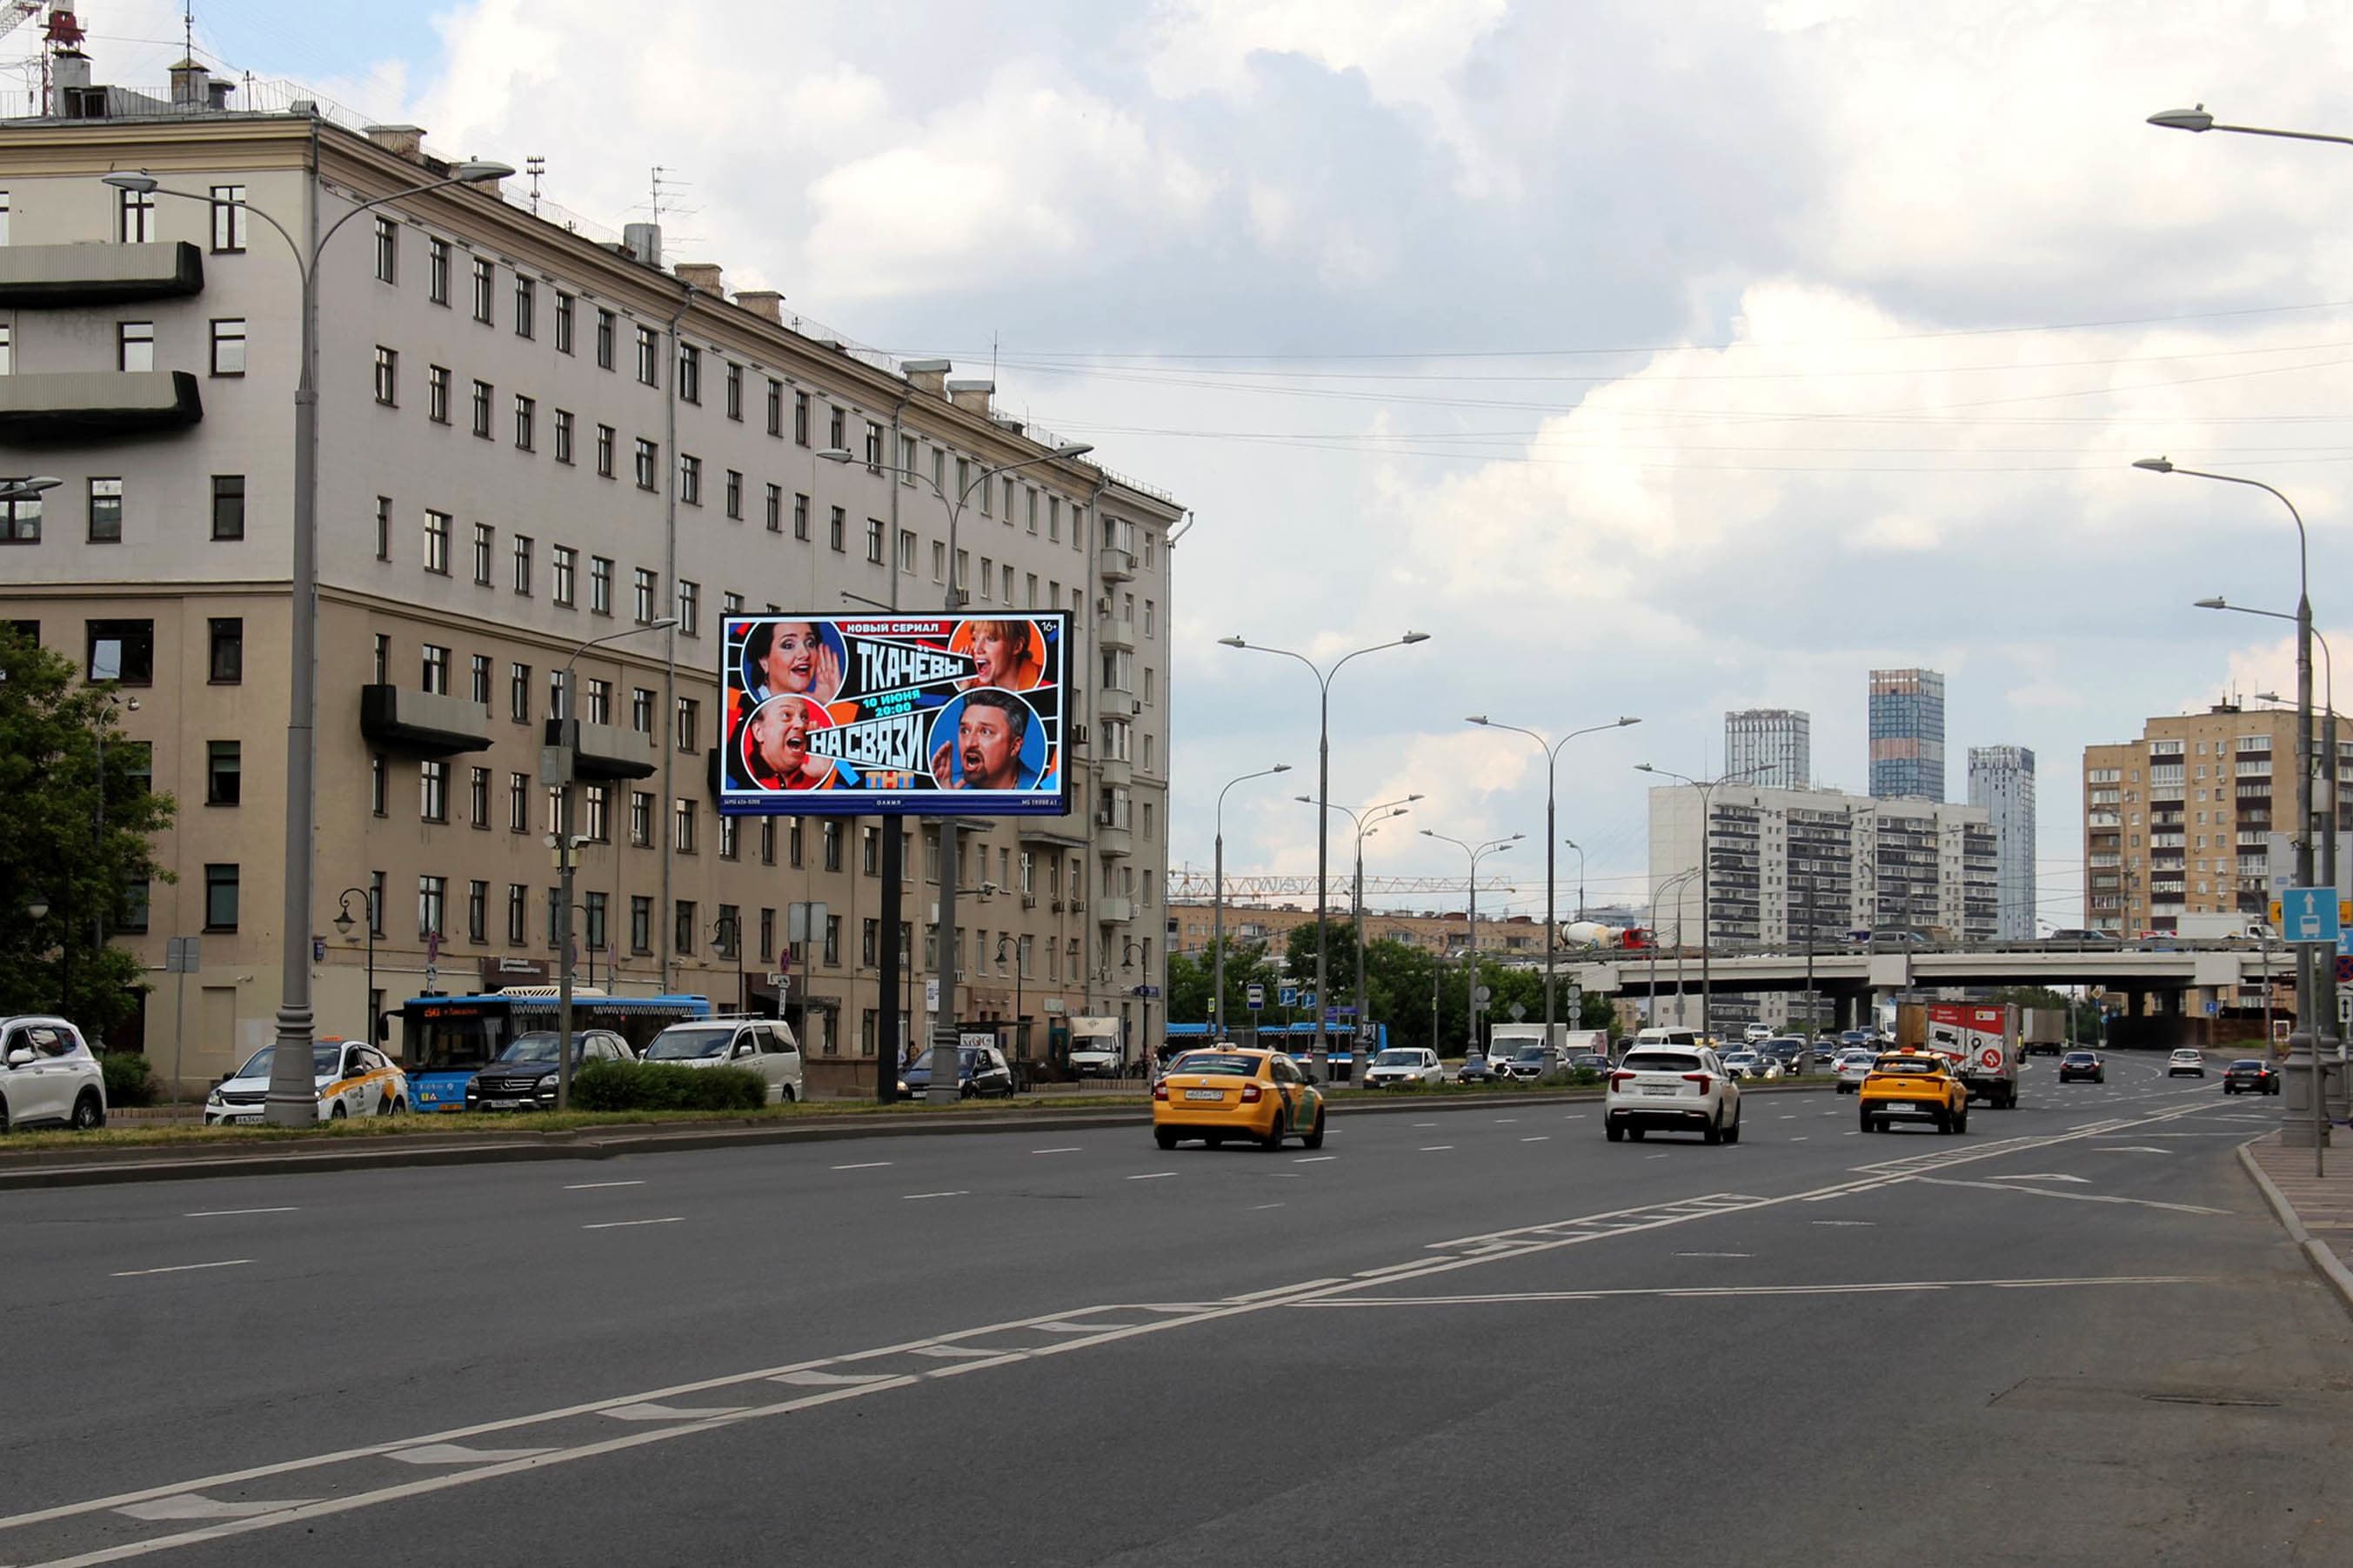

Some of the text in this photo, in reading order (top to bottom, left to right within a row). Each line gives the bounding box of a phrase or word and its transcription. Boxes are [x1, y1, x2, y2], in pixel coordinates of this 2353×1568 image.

[847, 624, 939, 633] НОВЫЙ СЕРИАЛ
[857, 642, 963, 692] ТКАЧЁВЫ
[863, 689, 920, 709] 10 ИЮНЯ
[875, 702, 912, 717] 20:00
[811, 713, 924, 771] НА СВЯЗИ
[866, 771, 914, 789] ТНТ
